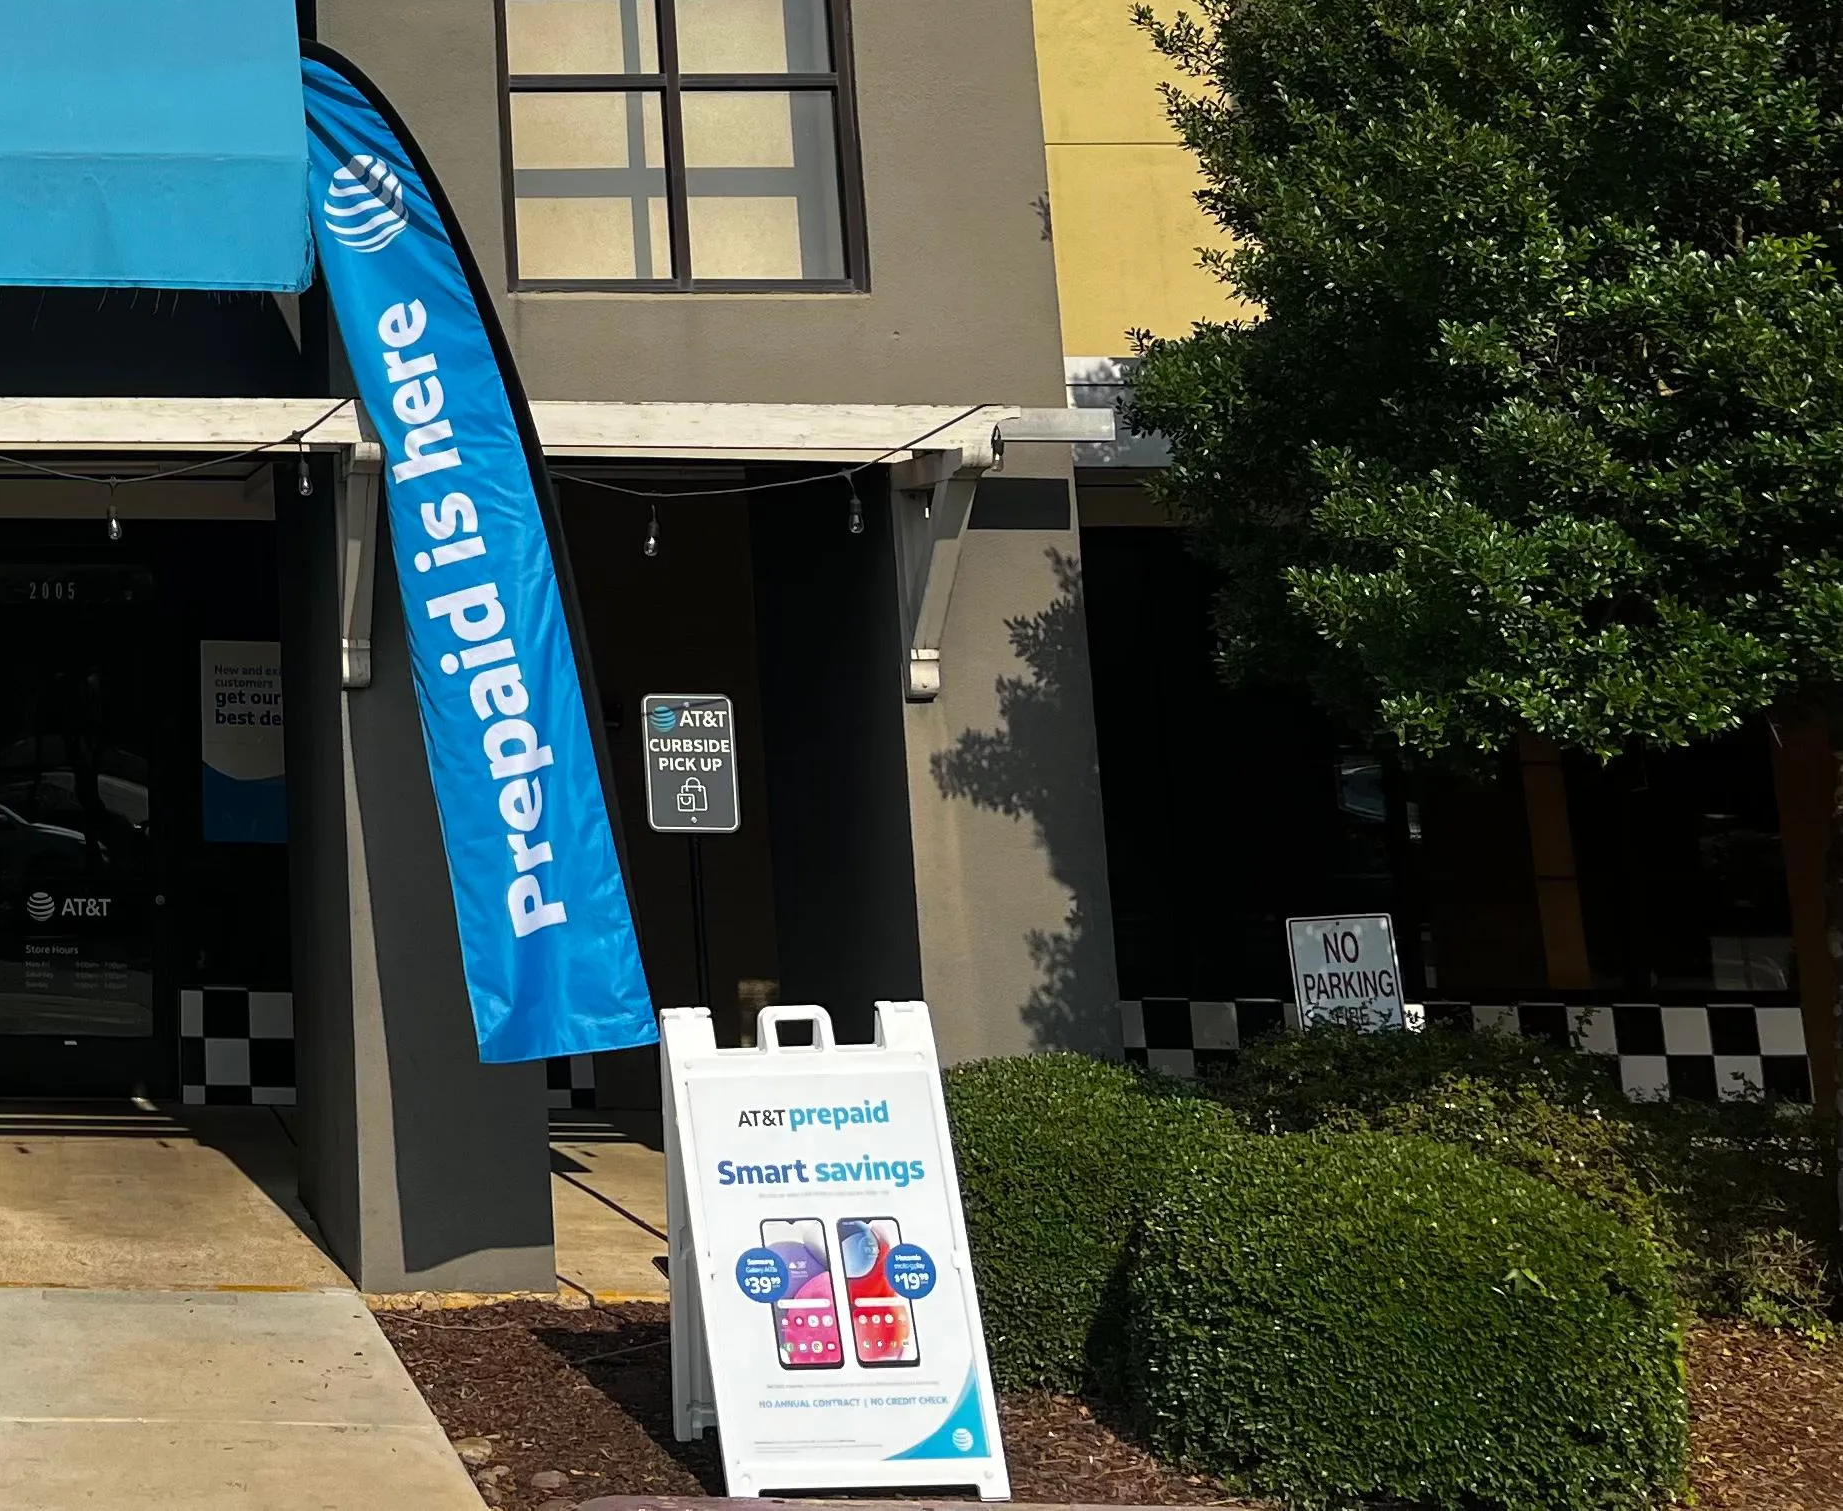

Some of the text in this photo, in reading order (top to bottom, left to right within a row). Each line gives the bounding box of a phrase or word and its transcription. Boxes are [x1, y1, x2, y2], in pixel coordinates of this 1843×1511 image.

[29, 581, 76, 601] 2005
[377, 298, 569, 940] Prepaid is here
[214, 664, 239, 676] New
[241, 665, 263, 676] and
[215, 678, 274, 689] customers
[215, 689, 281, 708] get our
[215, 709, 256, 725] best
[679, 710, 727, 728] AT&T
[649, 738, 730, 753] CURBSIDE
[658, 757, 723, 771] PICK UP
[61, 898, 112, 917] AT&T
[25, 945, 79, 955] Store Hours
[1322, 931, 1360, 964] NO
[1303, 969, 1396, 1004] PARKING
[738, 1100, 890, 1132] AT&T prepaid
[717, 1154, 925, 1188] Smart savings
[759, 1396, 949, 1408] NO ANNUAL CONTRACT NO CREDIT CHECK
